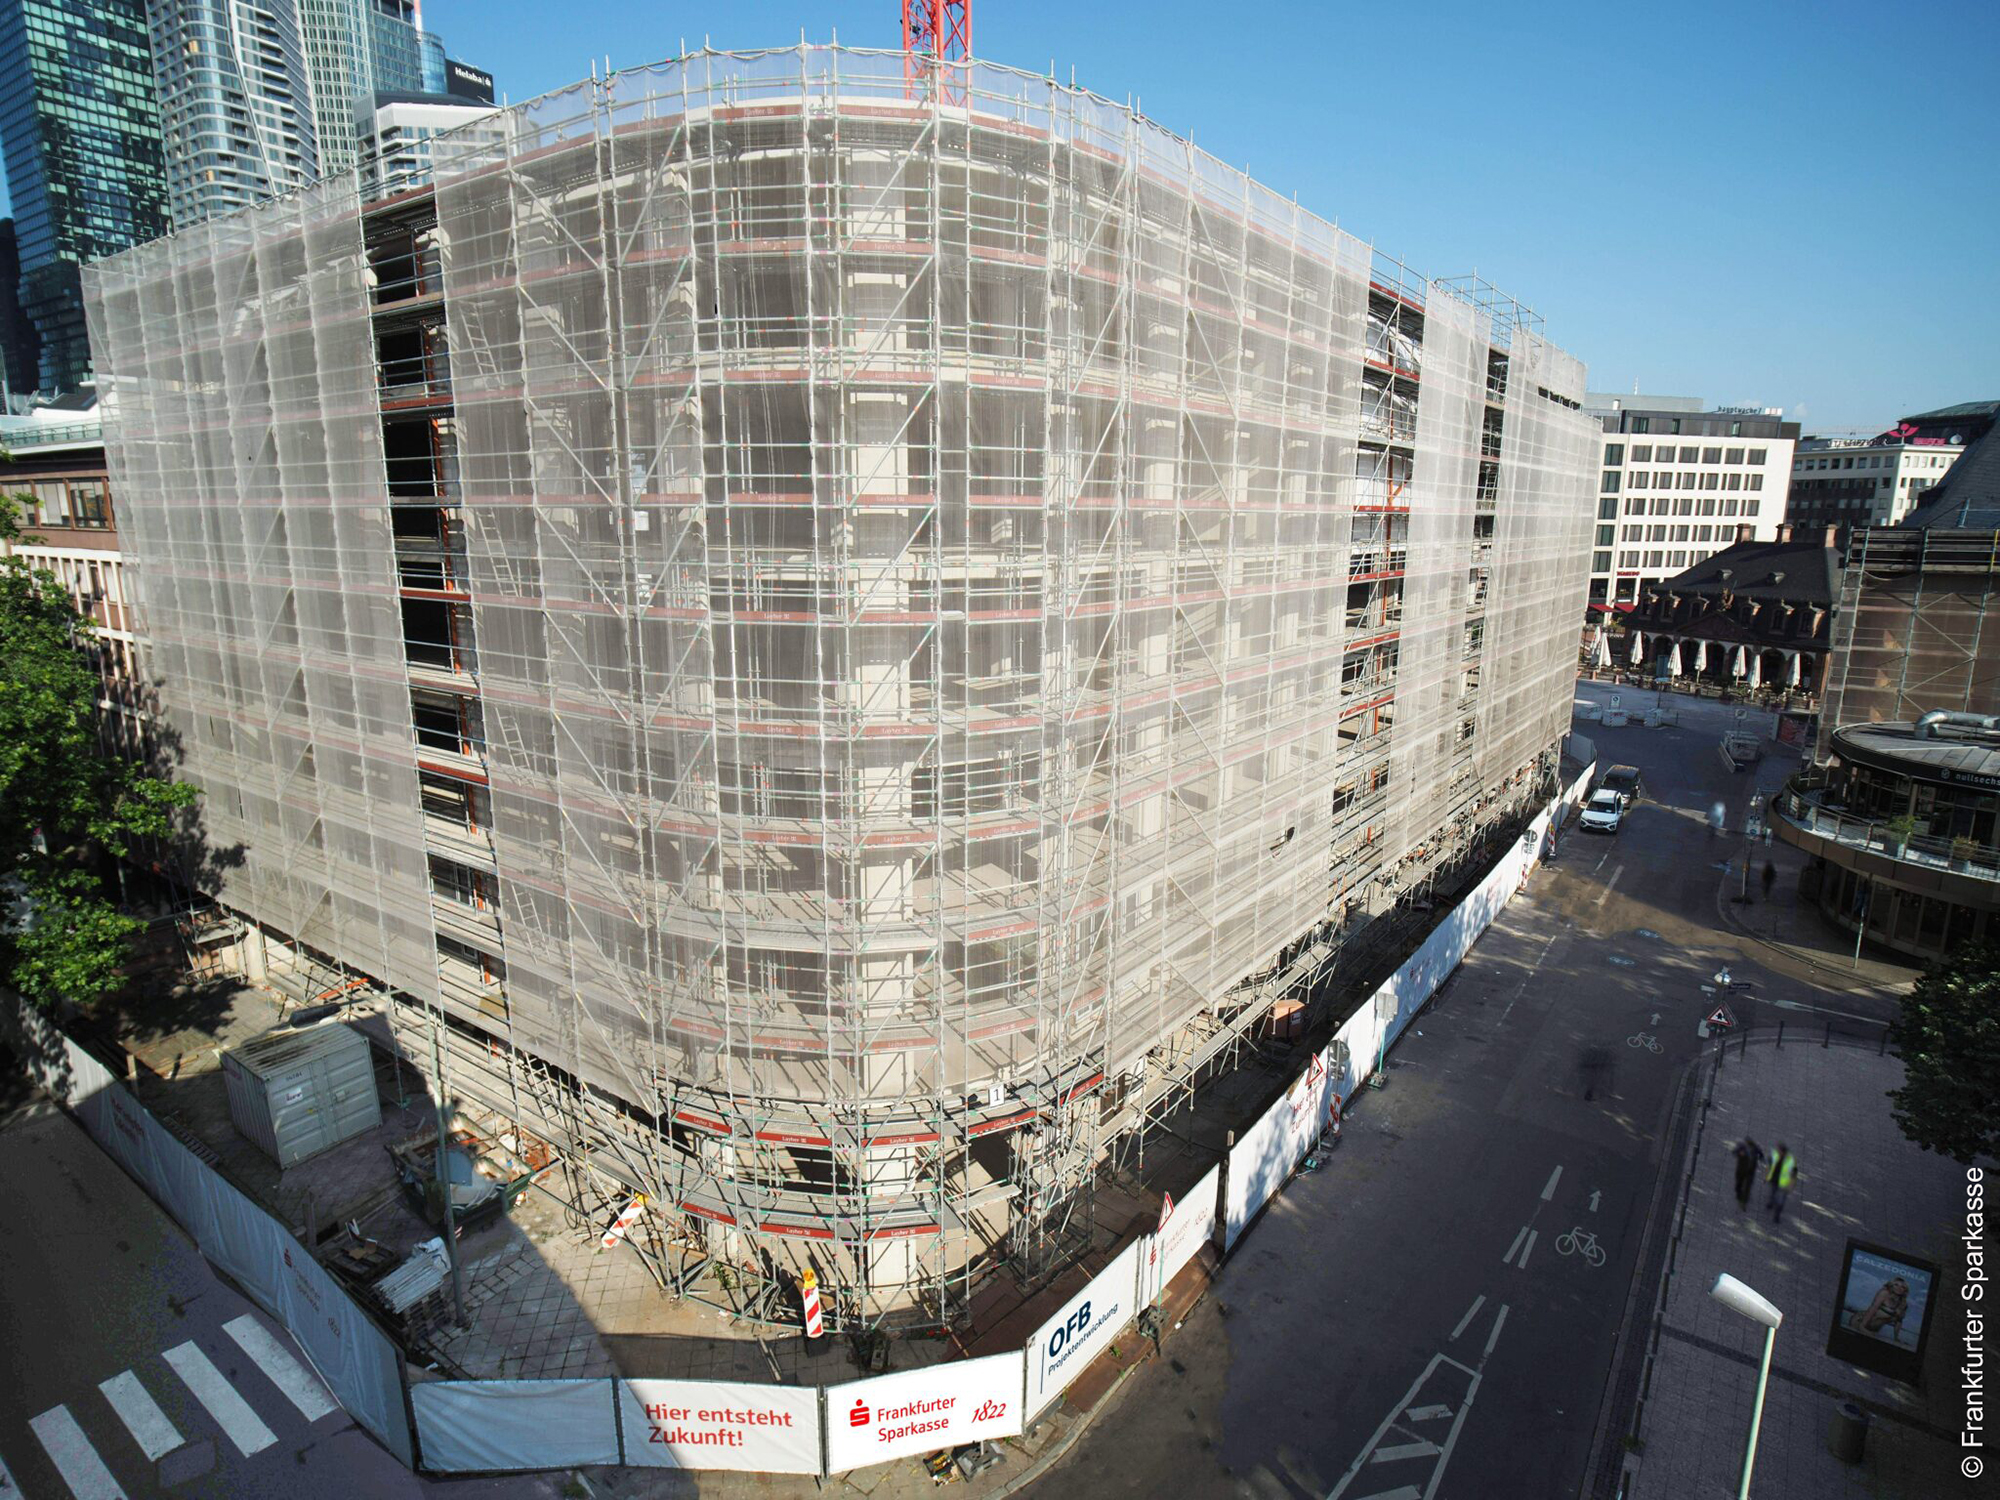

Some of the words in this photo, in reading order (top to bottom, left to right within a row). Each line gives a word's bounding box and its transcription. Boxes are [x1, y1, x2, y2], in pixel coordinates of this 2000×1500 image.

[455, 67, 482, 84] Helaba
[992, 1088, 1001, 1101] 1
[1855, 1254, 1927, 1283] CALZEDONIA
[1048, 1303, 1118, 1376] Projektentwicklung
[1049, 1300, 1091, 1358] OFB
[646, 1404, 691, 1420] Hier
[698, 1408, 793, 1427] entsteht
[877, 1397, 956, 1423] Frankfurter
[972, 1400, 1007, 1423] 1822
[649, 1426, 743, 1446] Zukunft!
[878, 1416, 950, 1443] Sparkasse
